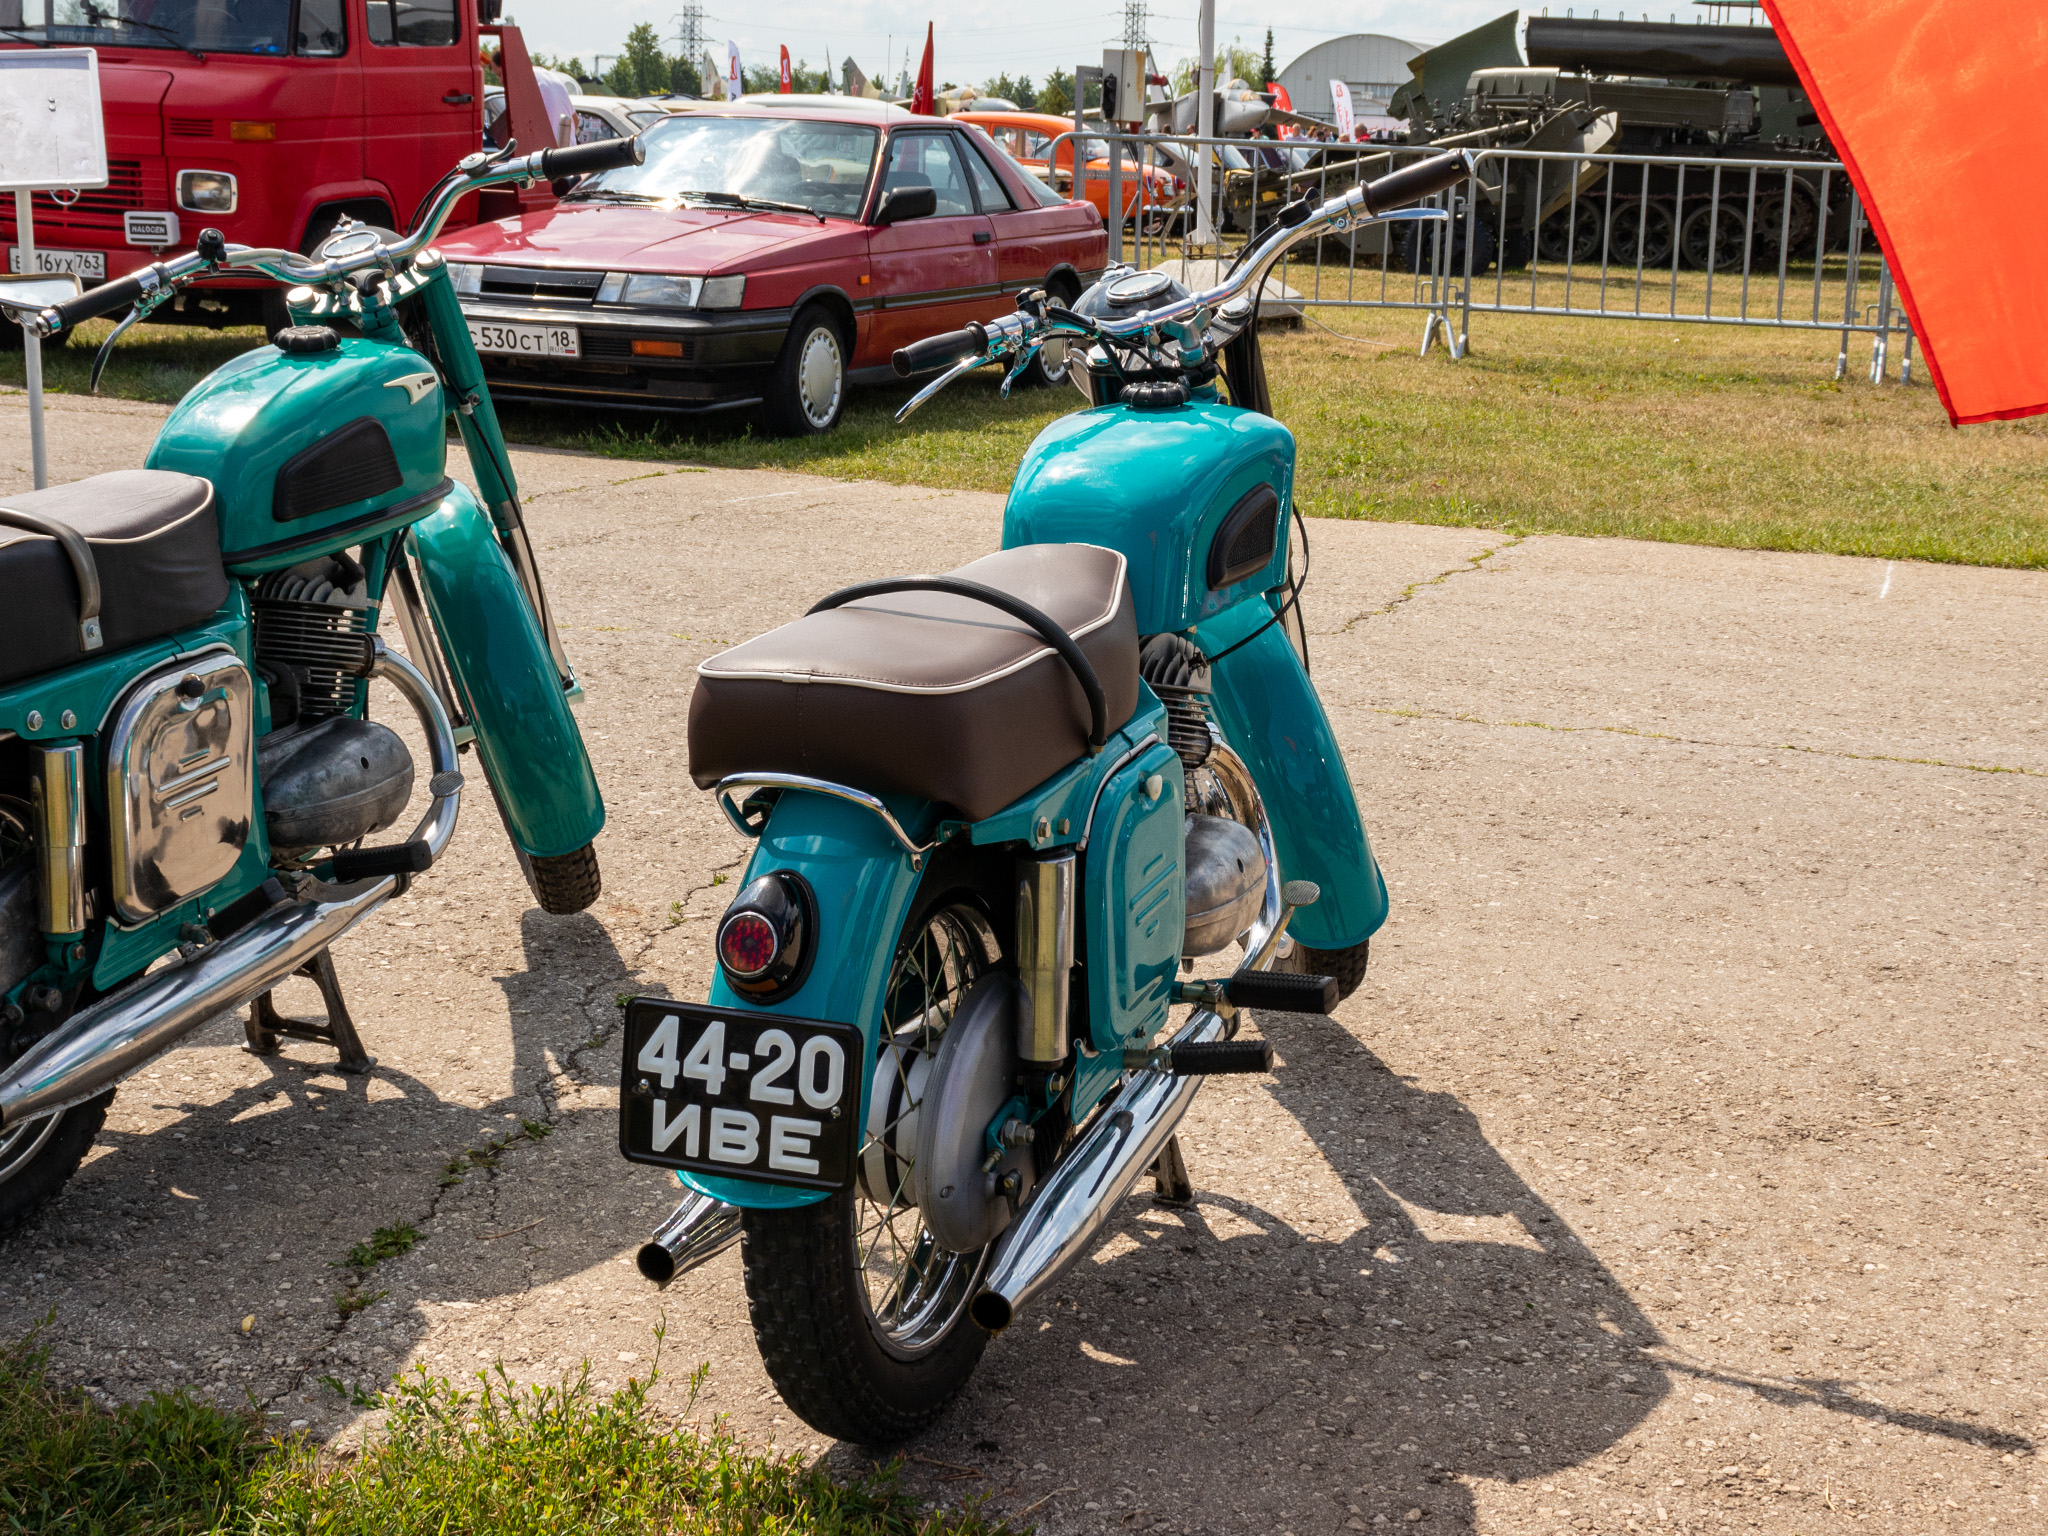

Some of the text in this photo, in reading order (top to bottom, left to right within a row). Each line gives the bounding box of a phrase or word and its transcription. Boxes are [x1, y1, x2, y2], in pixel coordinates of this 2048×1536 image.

[131, 225, 165, 234] HALOGEN
[76, 254, 100, 269] 763
[551, 330, 570, 347] 18
[549, 346, 565, 354] RUS
[637, 1014, 845, 1110] 44-20
[651, 1098, 822, 1175] ИВЕ
